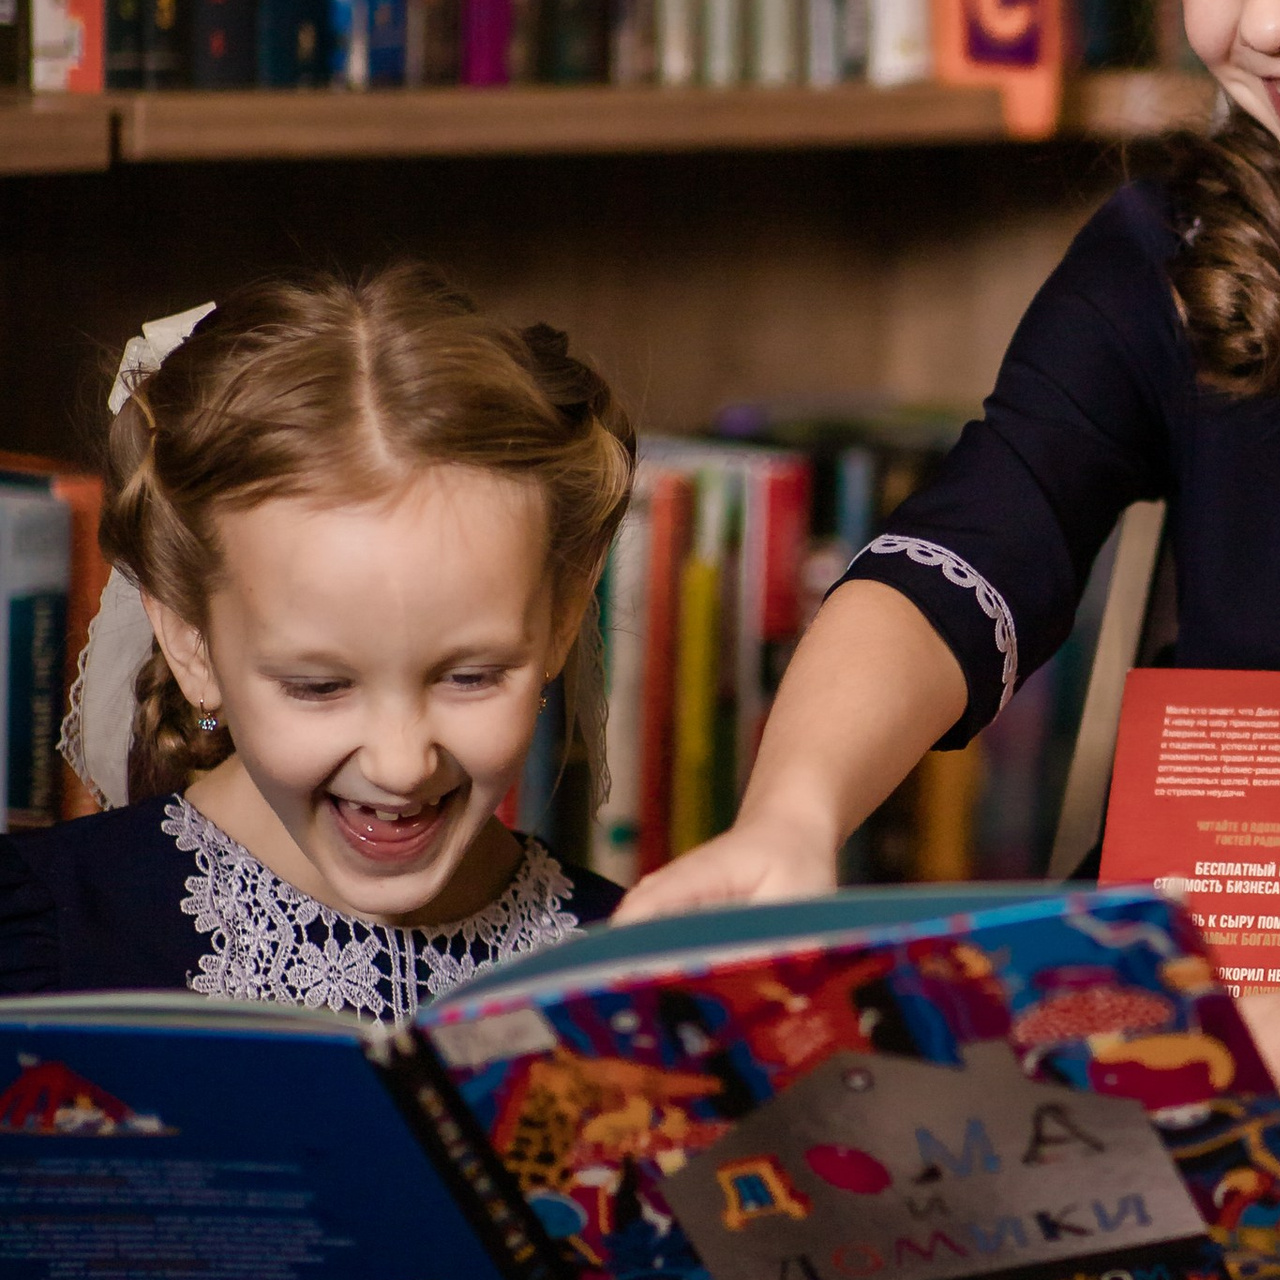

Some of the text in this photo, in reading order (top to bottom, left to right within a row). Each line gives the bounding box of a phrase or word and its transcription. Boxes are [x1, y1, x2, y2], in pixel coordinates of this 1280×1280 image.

[1195, 861, 1276, 877] БЕСПЛАТНЫЙ
[1153, 877, 1223, 893] СТМОСТЬ
[1226, 880, 1280, 894] БИЗНЕСА
[1208, 914, 1217, 928] К
[1220, 914, 1255, 929] СЫРУ
[1202, 931, 1238, 945] АМЫХ
[1216, 966, 1264, 982] ОКОРИЛ
[1225, 985, 1240, 998] ТО
